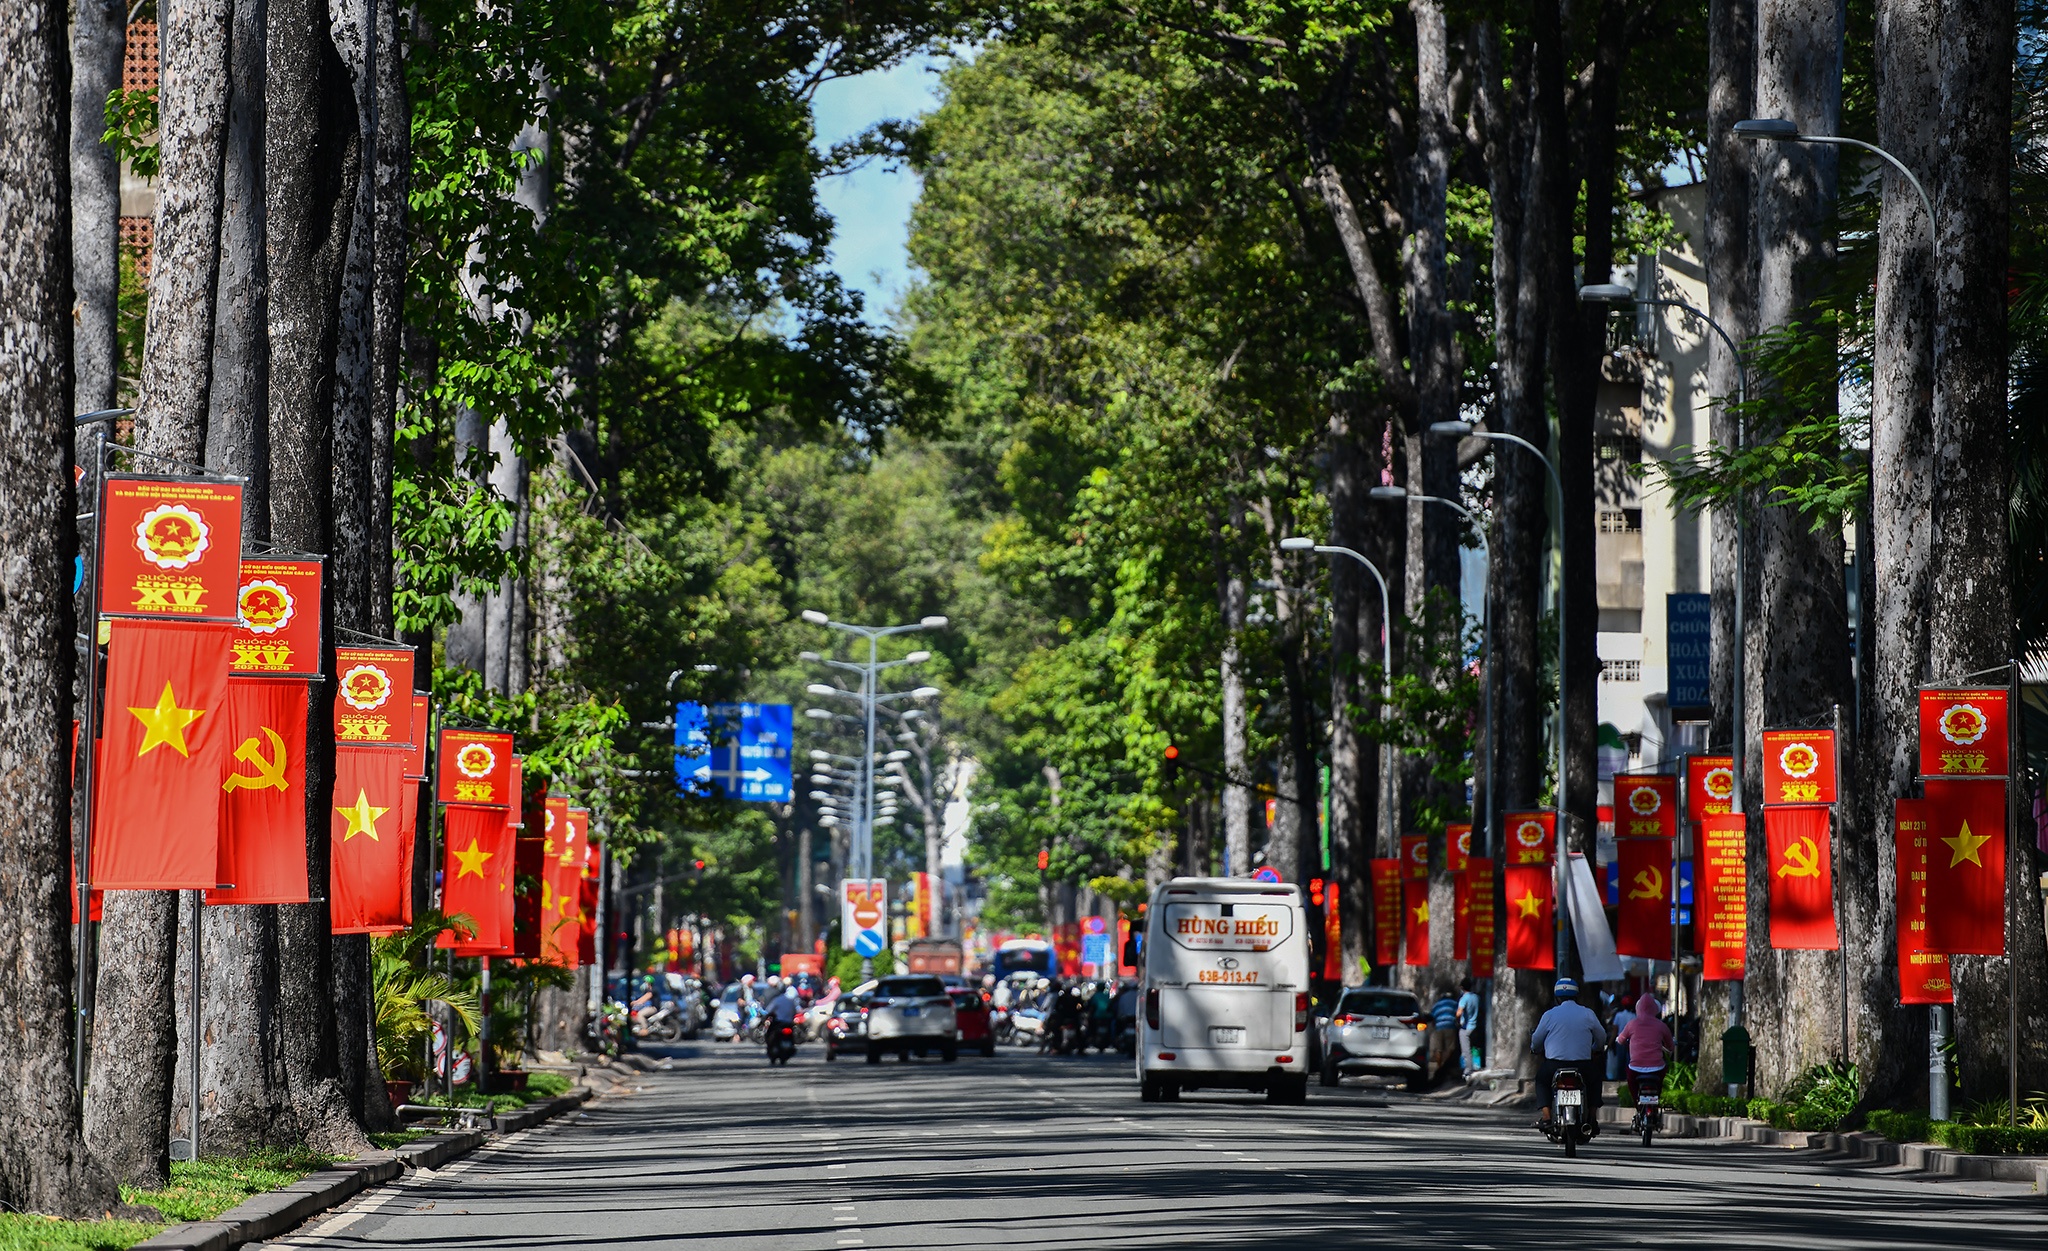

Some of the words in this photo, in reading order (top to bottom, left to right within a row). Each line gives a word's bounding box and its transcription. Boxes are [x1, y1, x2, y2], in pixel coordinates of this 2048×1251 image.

[137, 574, 176, 582] QUỐC
[137, 581, 204, 590] KHÓA
[137, 588, 204, 606] XV
[137, 604, 203, 613] 2021-2026
[1670, 618, 1710, 634] CHỨN
[1670, 639, 1710, 658] HOÀN
[234, 651, 290, 665] XV
[1676, 661, 1709, 680] XUÂ
[342, 724, 388, 736] XV
[1942, 758, 1986, 769] XV
[1900, 820, 1913, 830] NGÀY
[1914, 821, 1920, 830] 23
[1199, 970, 1259, 983] 63B-013.47
